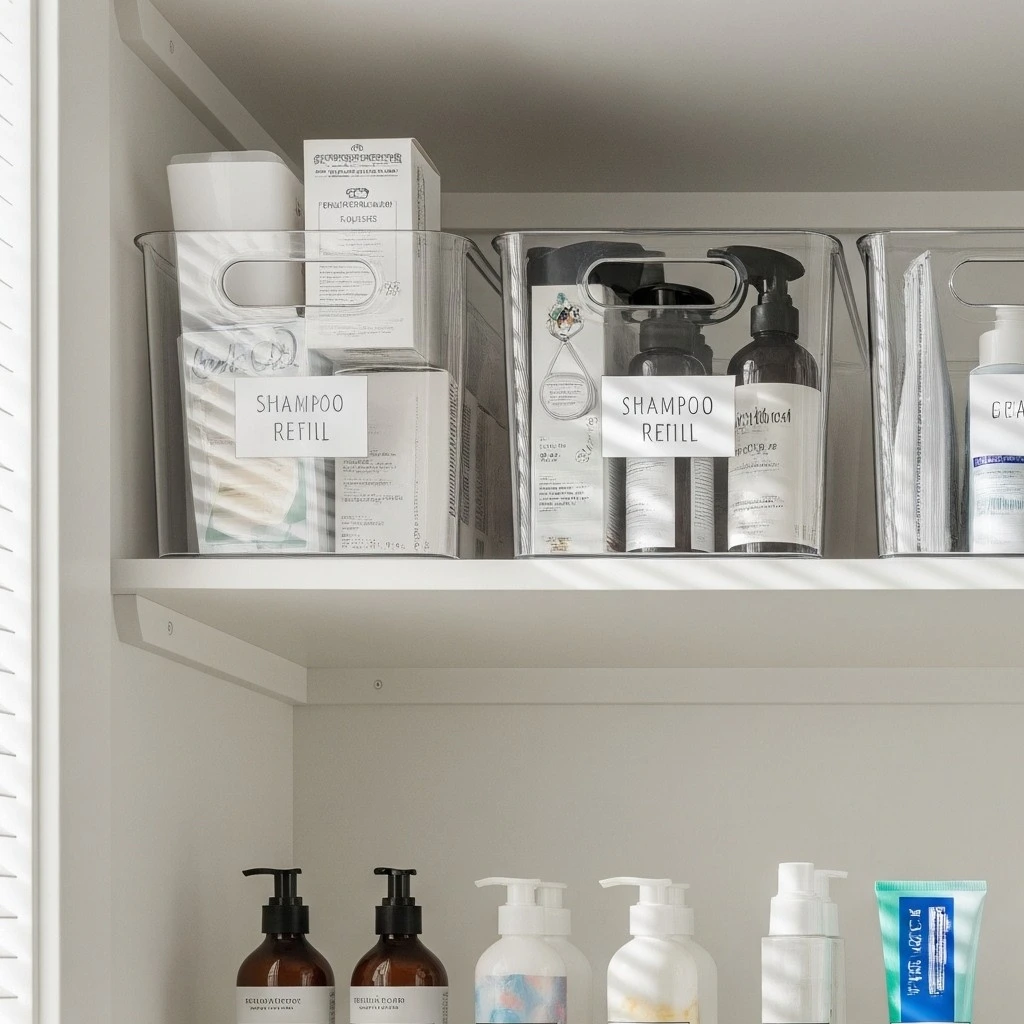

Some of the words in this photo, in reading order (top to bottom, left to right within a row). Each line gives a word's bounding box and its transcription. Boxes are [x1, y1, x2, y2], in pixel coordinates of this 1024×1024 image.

[256, 394, 344, 413] SHAMPOO
[622, 396, 713, 416] SHAMPOO
[273, 421, 330, 442] REFILL
